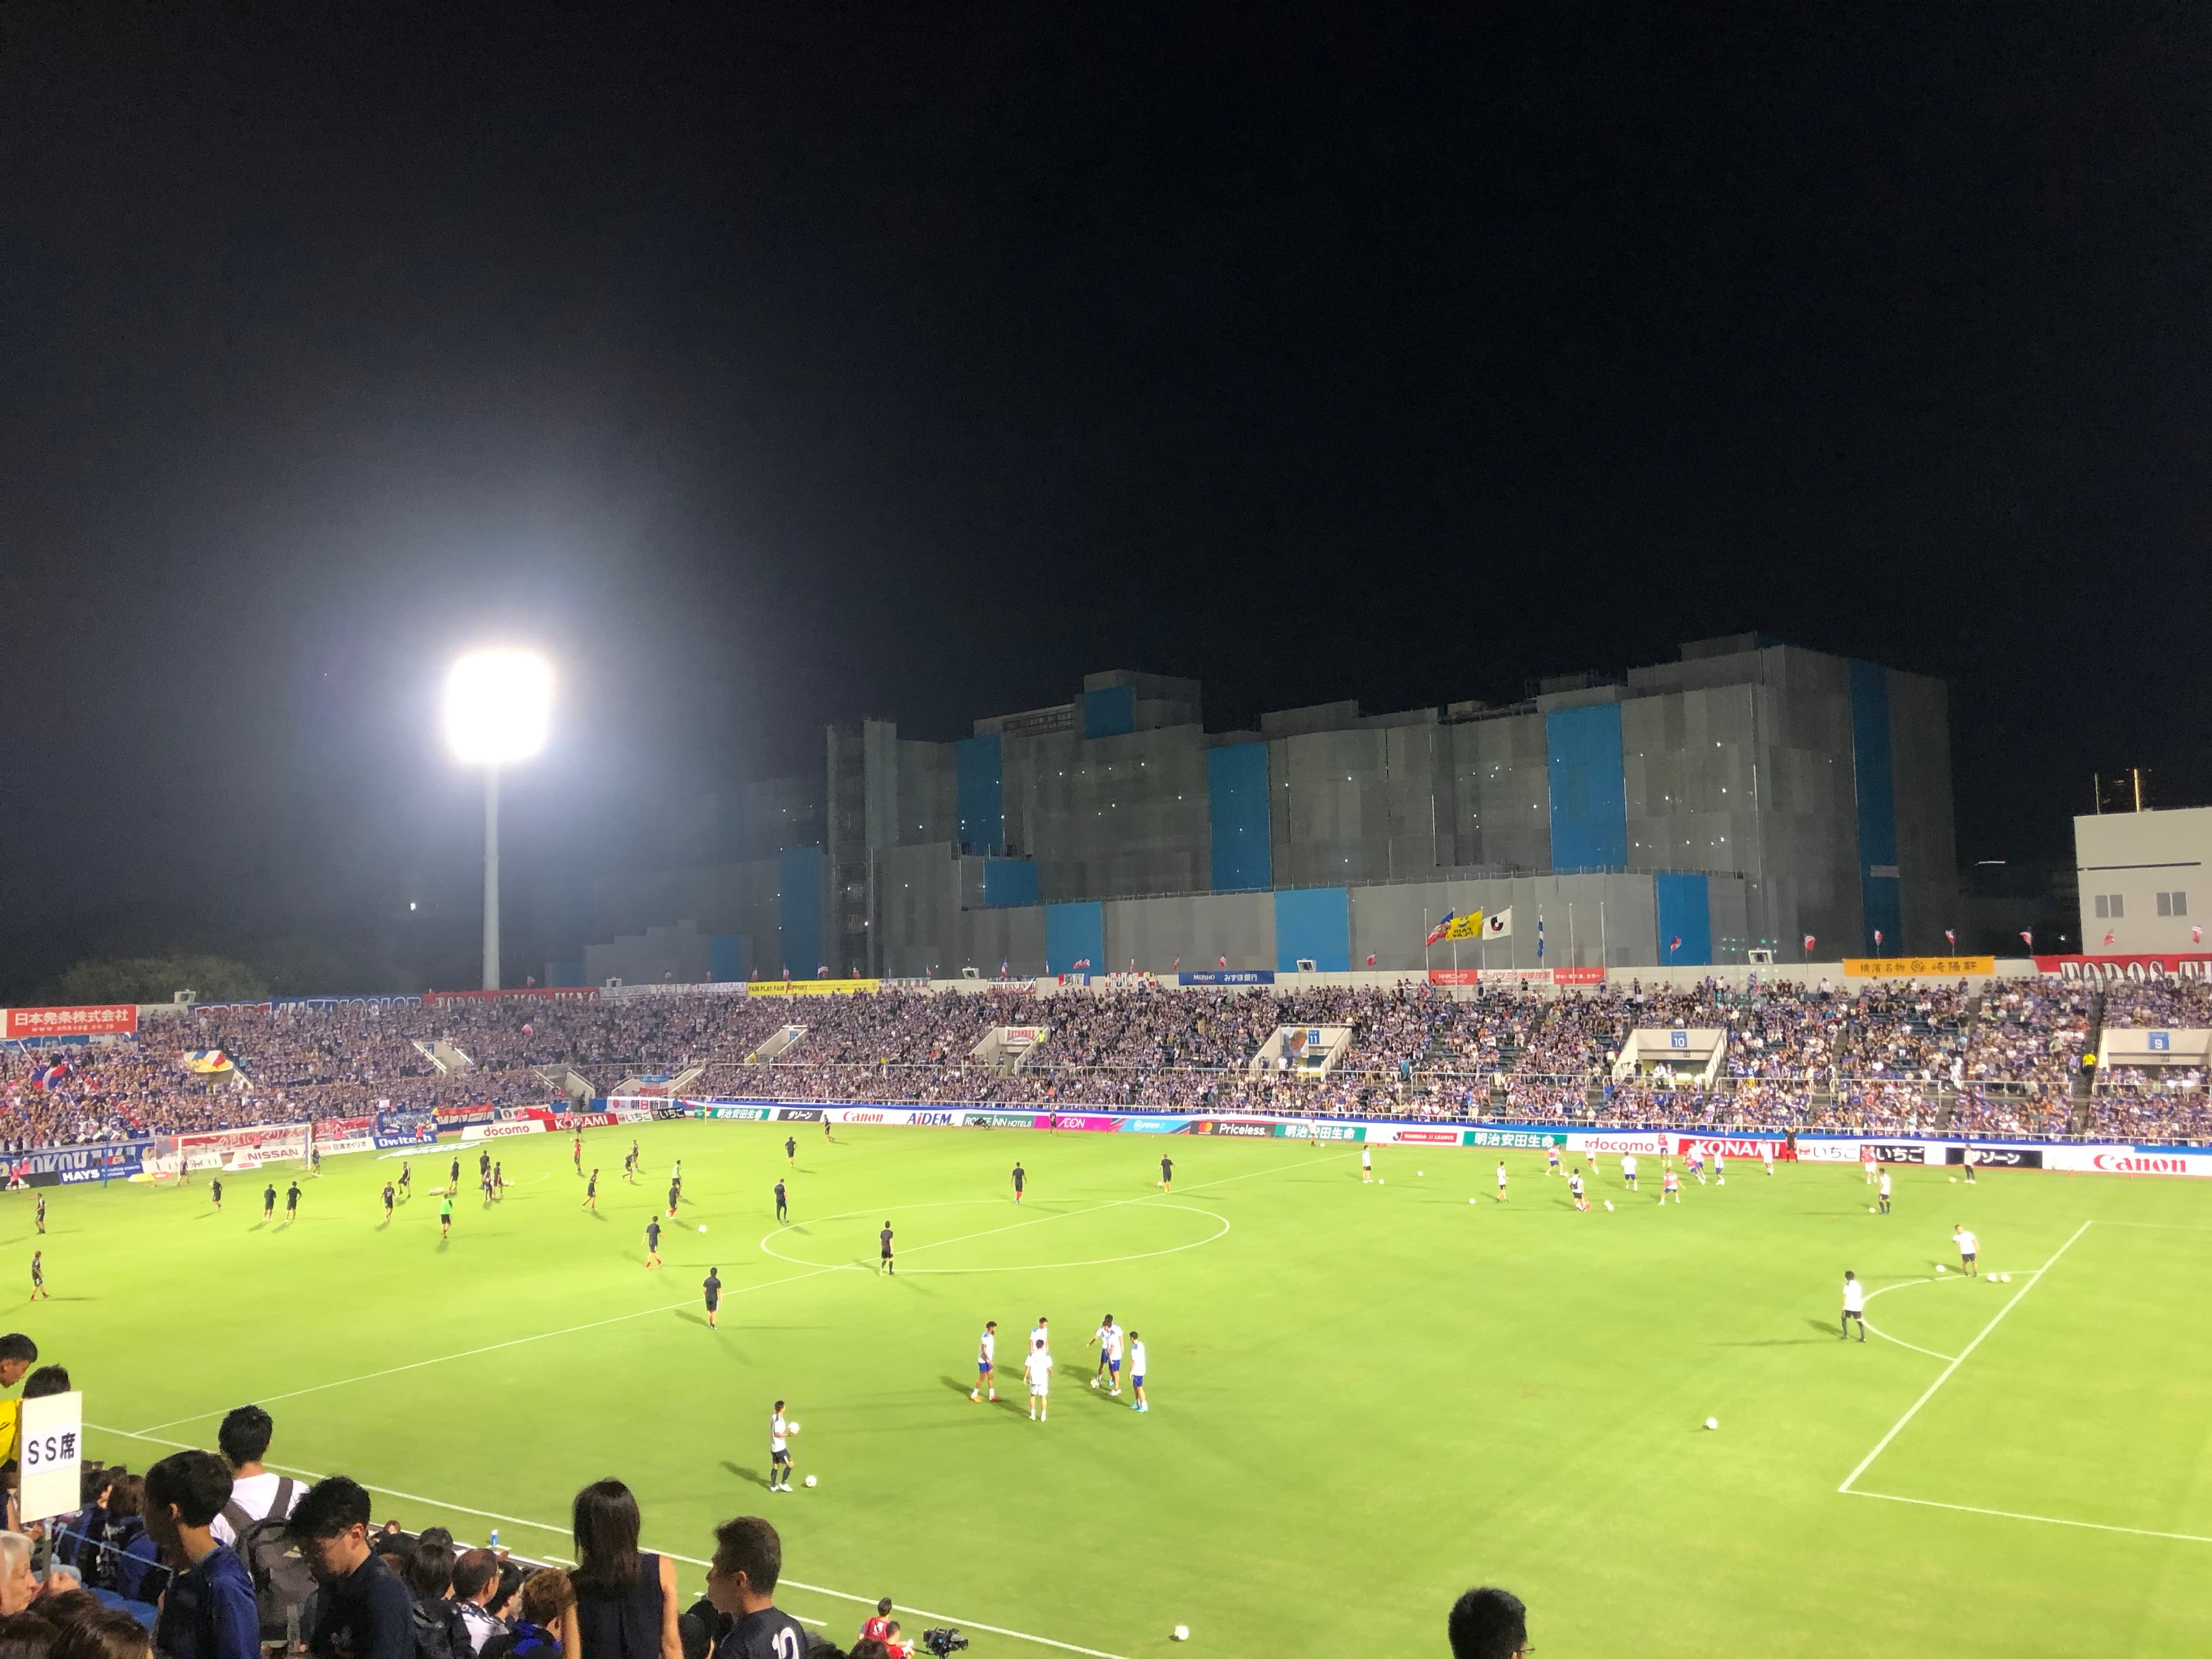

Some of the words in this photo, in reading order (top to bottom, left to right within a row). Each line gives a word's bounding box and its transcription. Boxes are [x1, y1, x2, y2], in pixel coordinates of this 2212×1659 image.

[1224, 974, 1257, 982] みずほ銀行
[15, 1009, 129, 1026] 日本発条株式会社
[1309, 1035, 1317, 1044] 11
[1673, 1037, 1685, 1047] 10
[843, 1111, 884, 1123] Canon
[964, 1116, 992, 1126] ROE
[483, 1125, 530, 1137] docomo
[1474, 1132, 1555, 1149] 明治安田生命
[1589, 1137, 1654, 1152] docomo
[247, 1149, 299, 1161] NISSAN
[1876, 1146, 1925, 1162] いちご
[2093, 1154, 2187, 1173] Canon
[62, 1169, 100, 1182] HAYS
[28, 1432, 76, 1465] SS席
